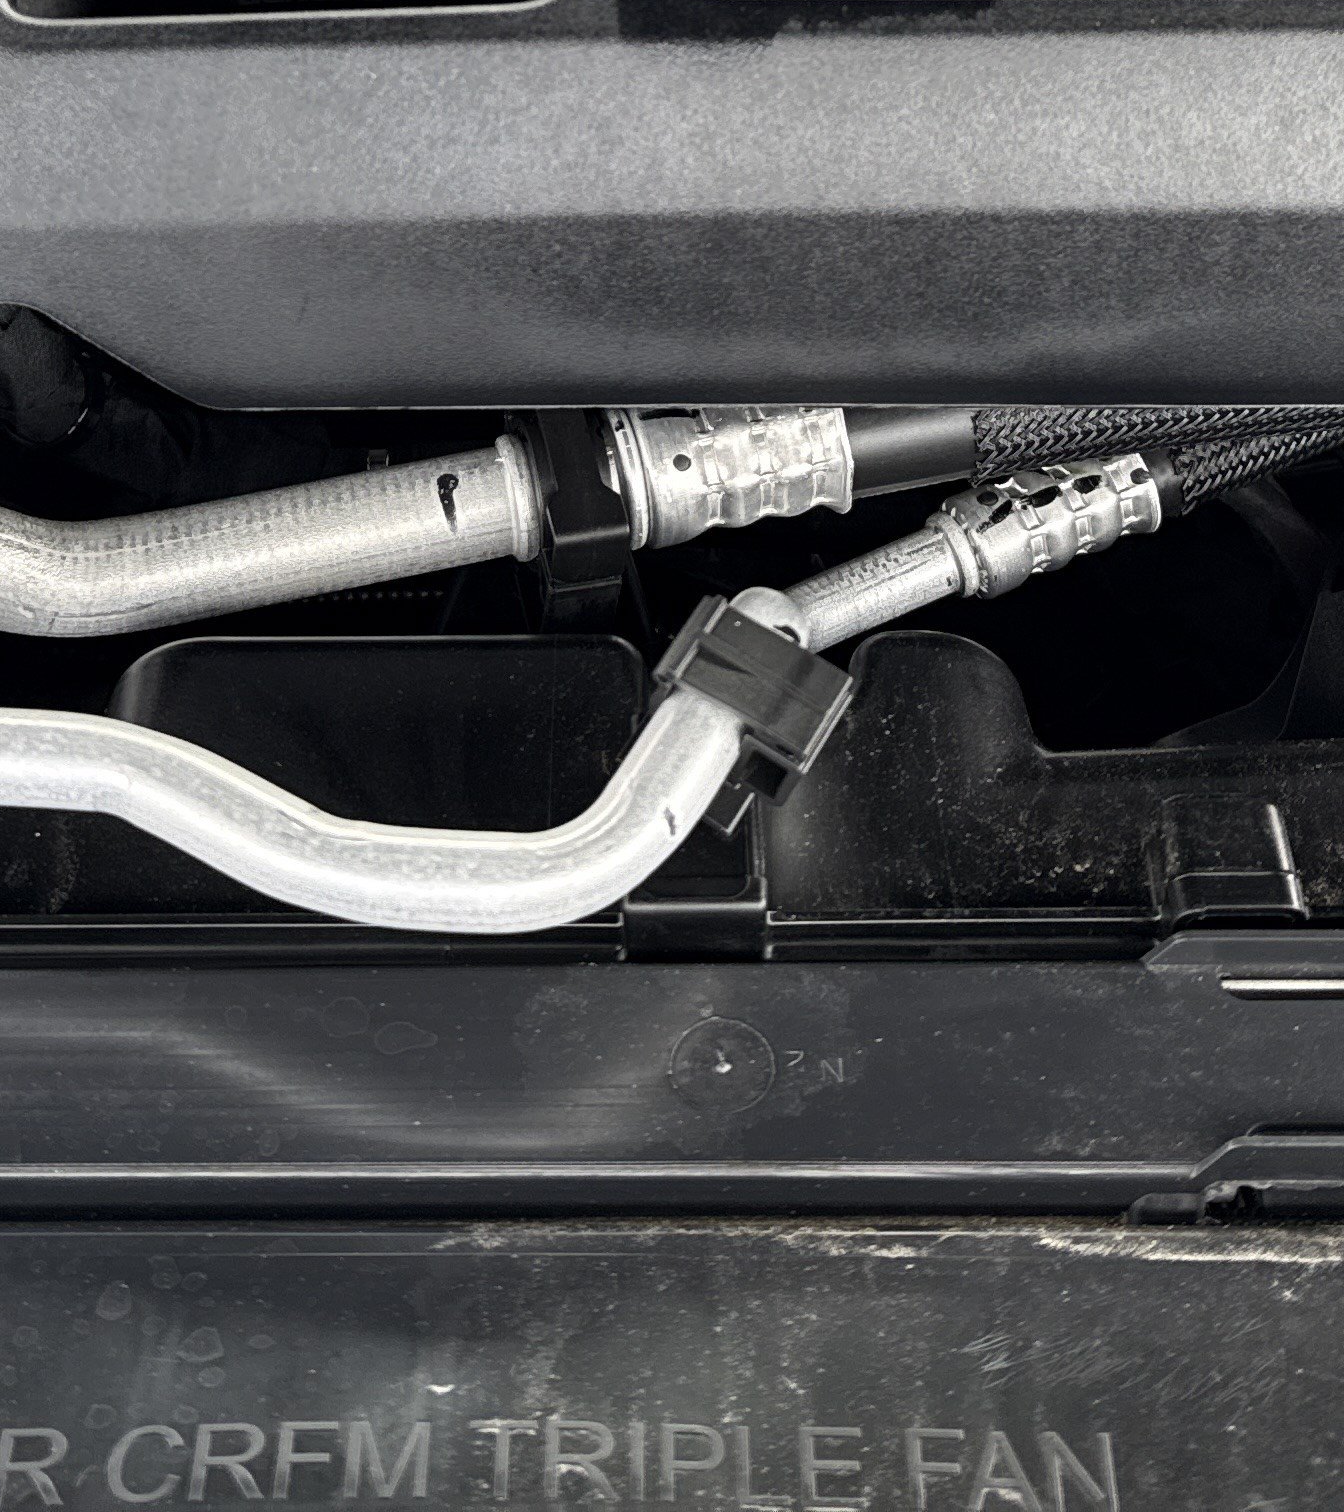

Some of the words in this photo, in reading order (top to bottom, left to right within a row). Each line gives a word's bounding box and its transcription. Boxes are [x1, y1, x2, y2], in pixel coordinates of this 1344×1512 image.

[105, 1418, 433, 1507] CRFM
[467, 1419, 870, 1510] TRIPLE
[905, 1425, 1121, 1512] FAN
